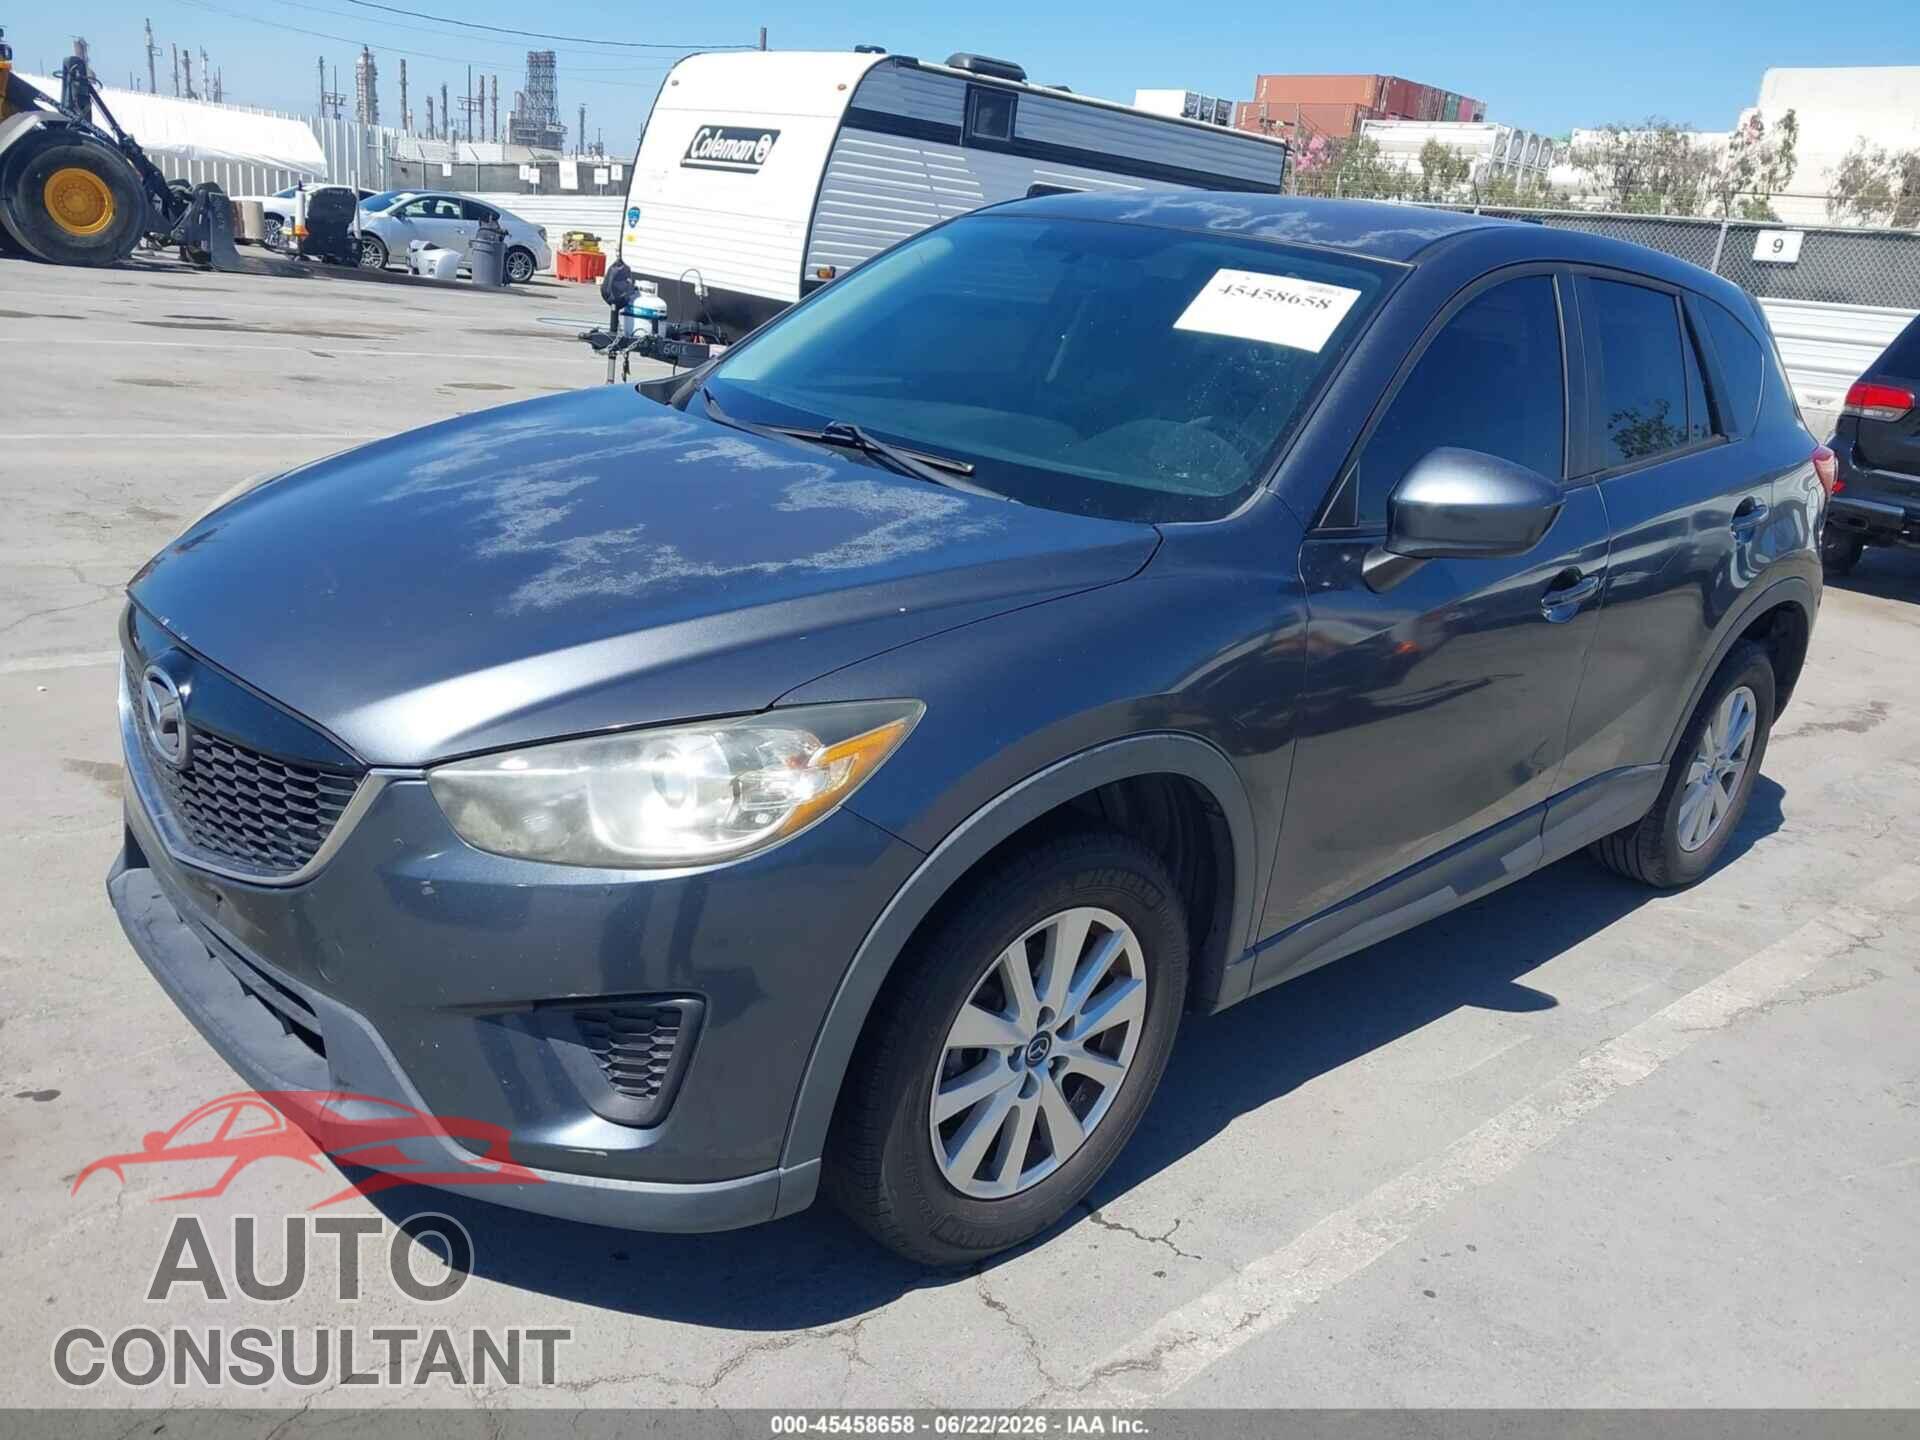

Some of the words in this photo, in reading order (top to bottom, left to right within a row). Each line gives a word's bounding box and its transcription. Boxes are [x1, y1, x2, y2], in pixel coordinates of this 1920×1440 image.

[690, 127, 757, 161] Coleman
[1772, 238, 1784, 253] 9
[1217, 284, 1332, 310] 45458658
